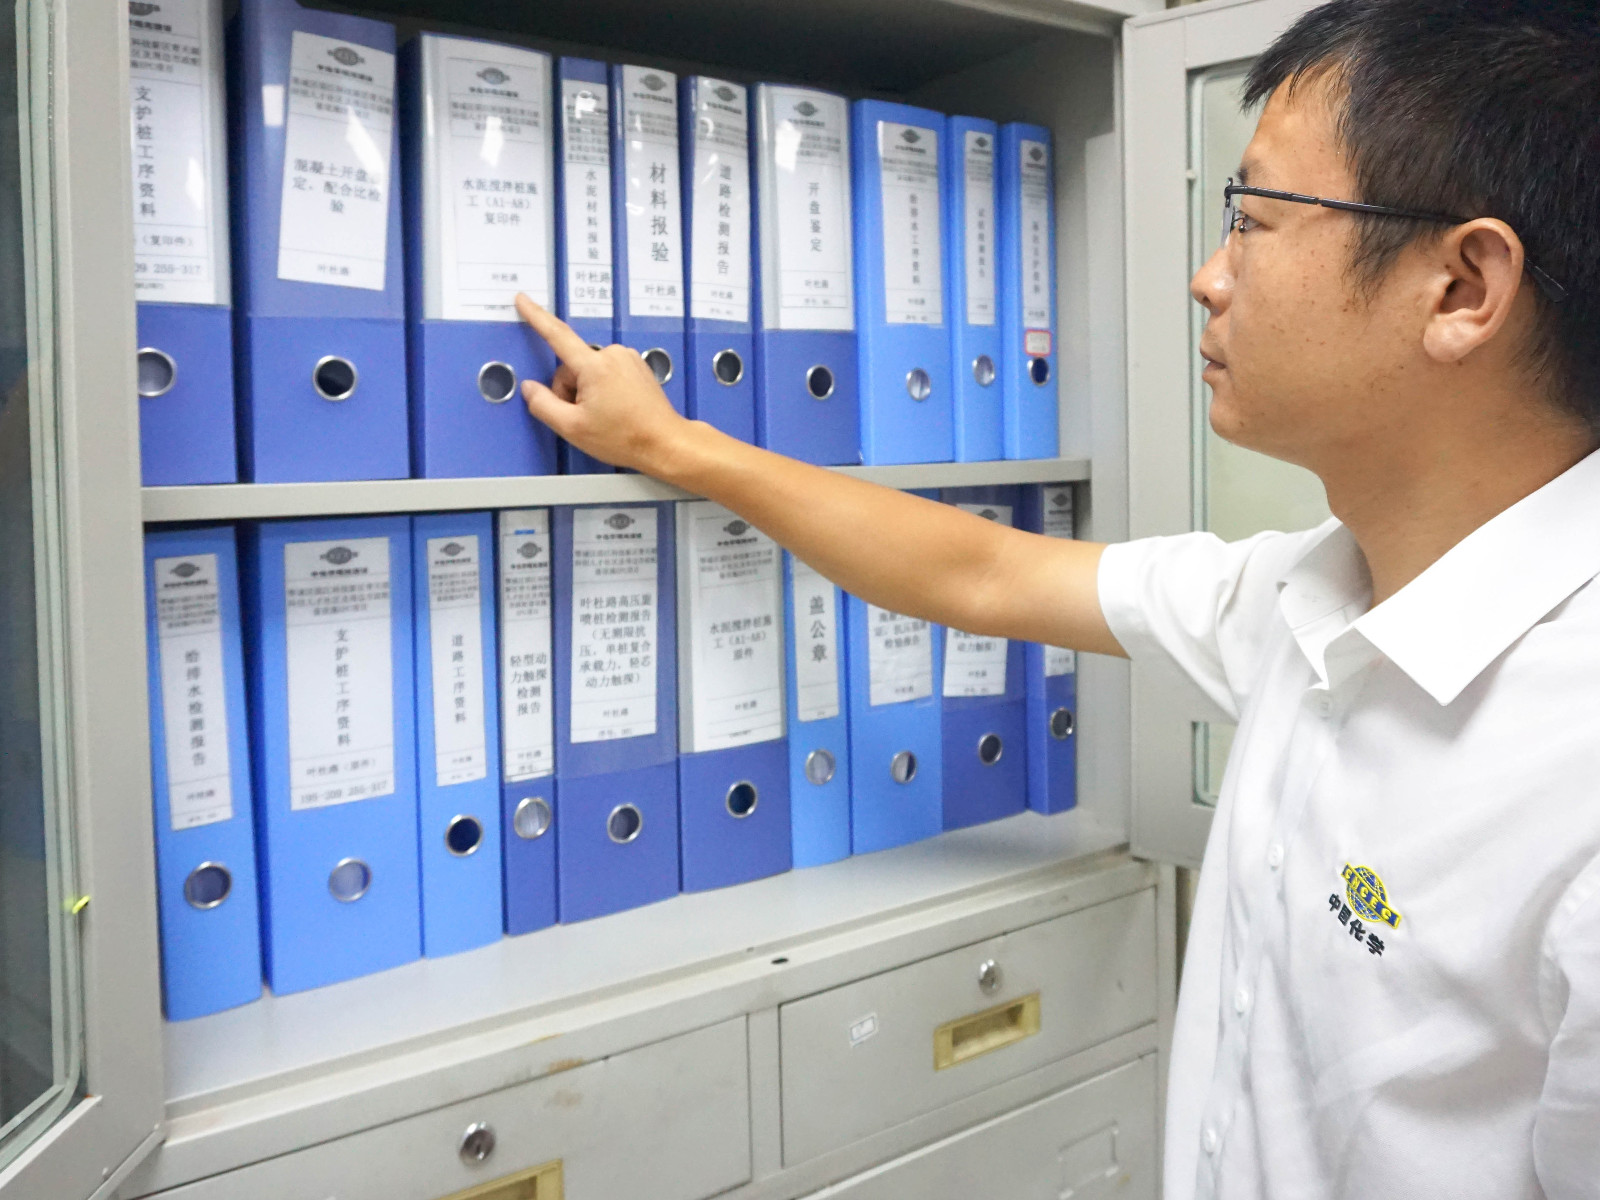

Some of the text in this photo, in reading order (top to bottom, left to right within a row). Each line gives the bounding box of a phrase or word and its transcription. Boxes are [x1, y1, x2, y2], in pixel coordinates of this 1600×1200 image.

[294, 158, 381, 184] 混凝土开盘
[649, 161, 670, 263] 材料报验
[809, 595, 827, 663] 盖公章
[1328, 893, 1385, 957] 中国化学
[1344, 868, 1392, 920] CNCEC
